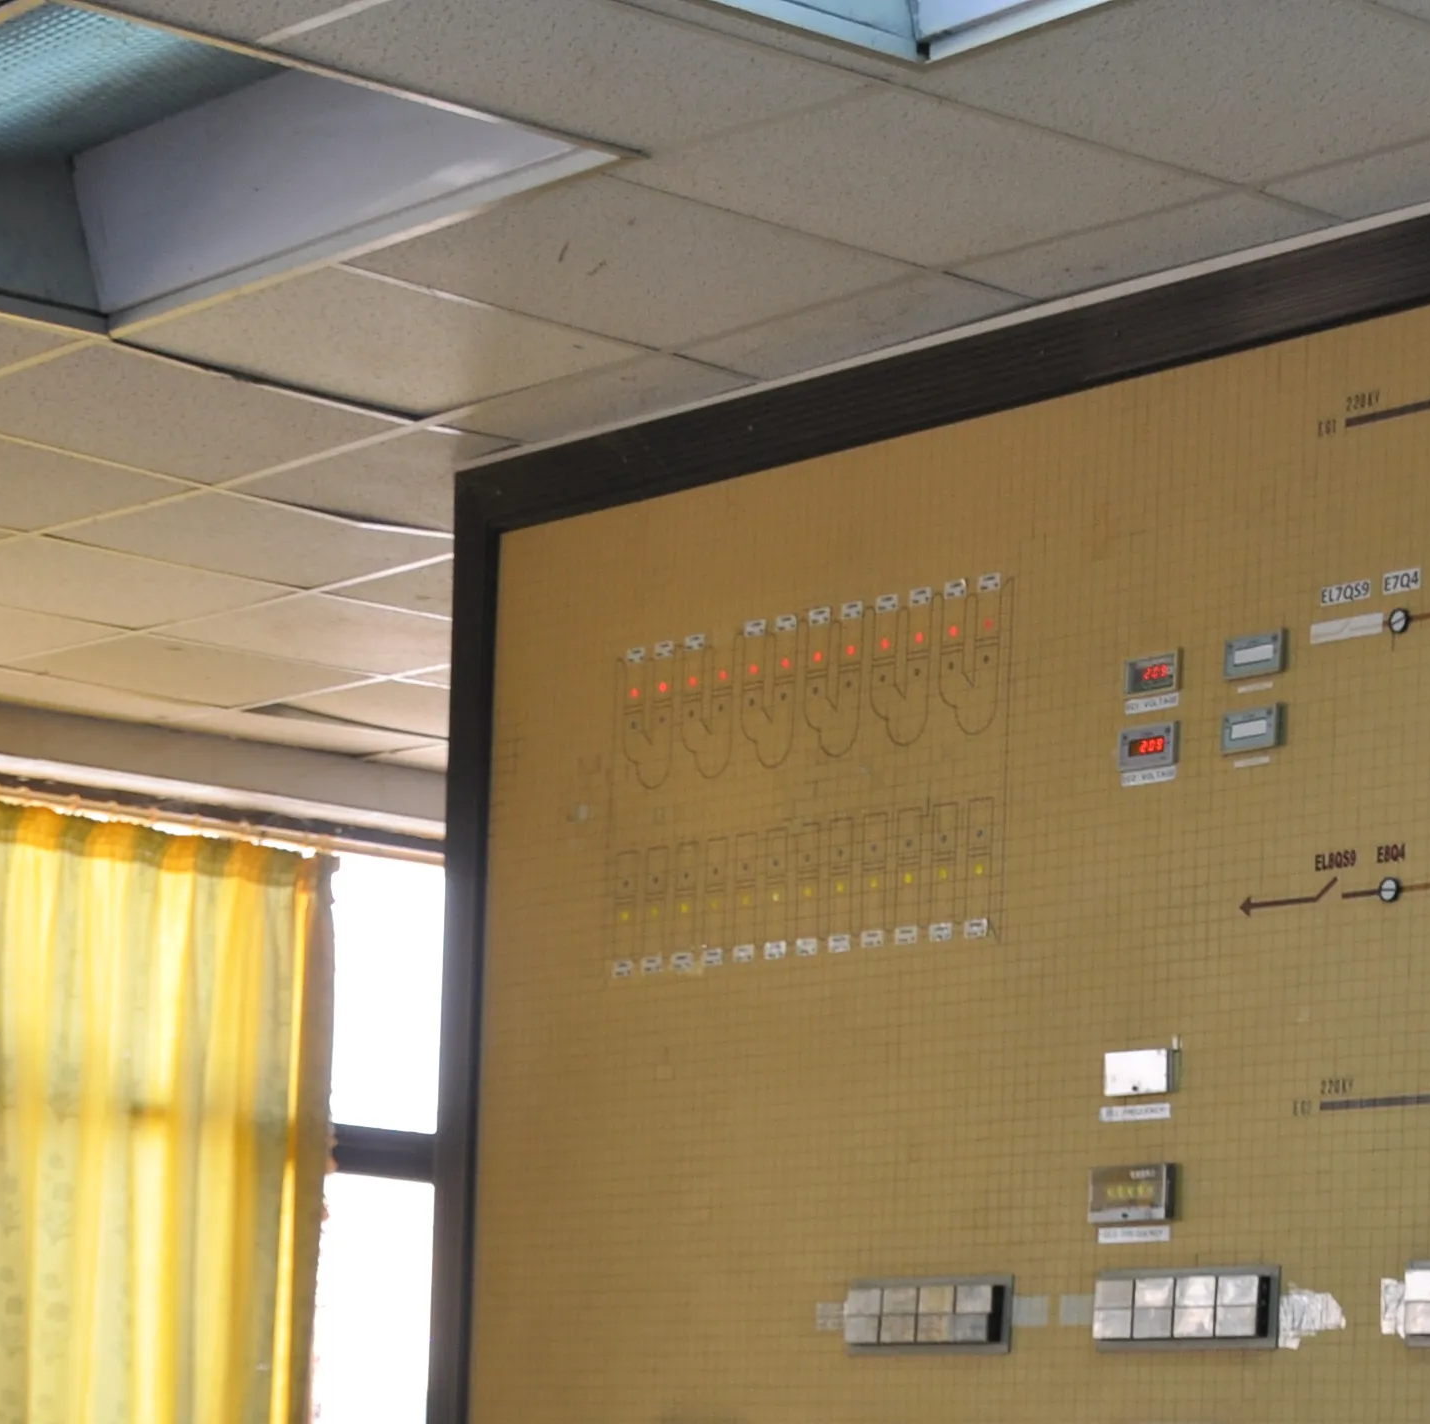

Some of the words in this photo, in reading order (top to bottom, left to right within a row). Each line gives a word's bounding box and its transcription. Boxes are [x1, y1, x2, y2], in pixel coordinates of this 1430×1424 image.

[1321, 580, 1370, 604] EL7QS9
[1384, 571, 1419, 592] E7Q4
[1315, 850, 1356, 871] EL8QS9
[1377, 844, 1405, 863] E8Q4
